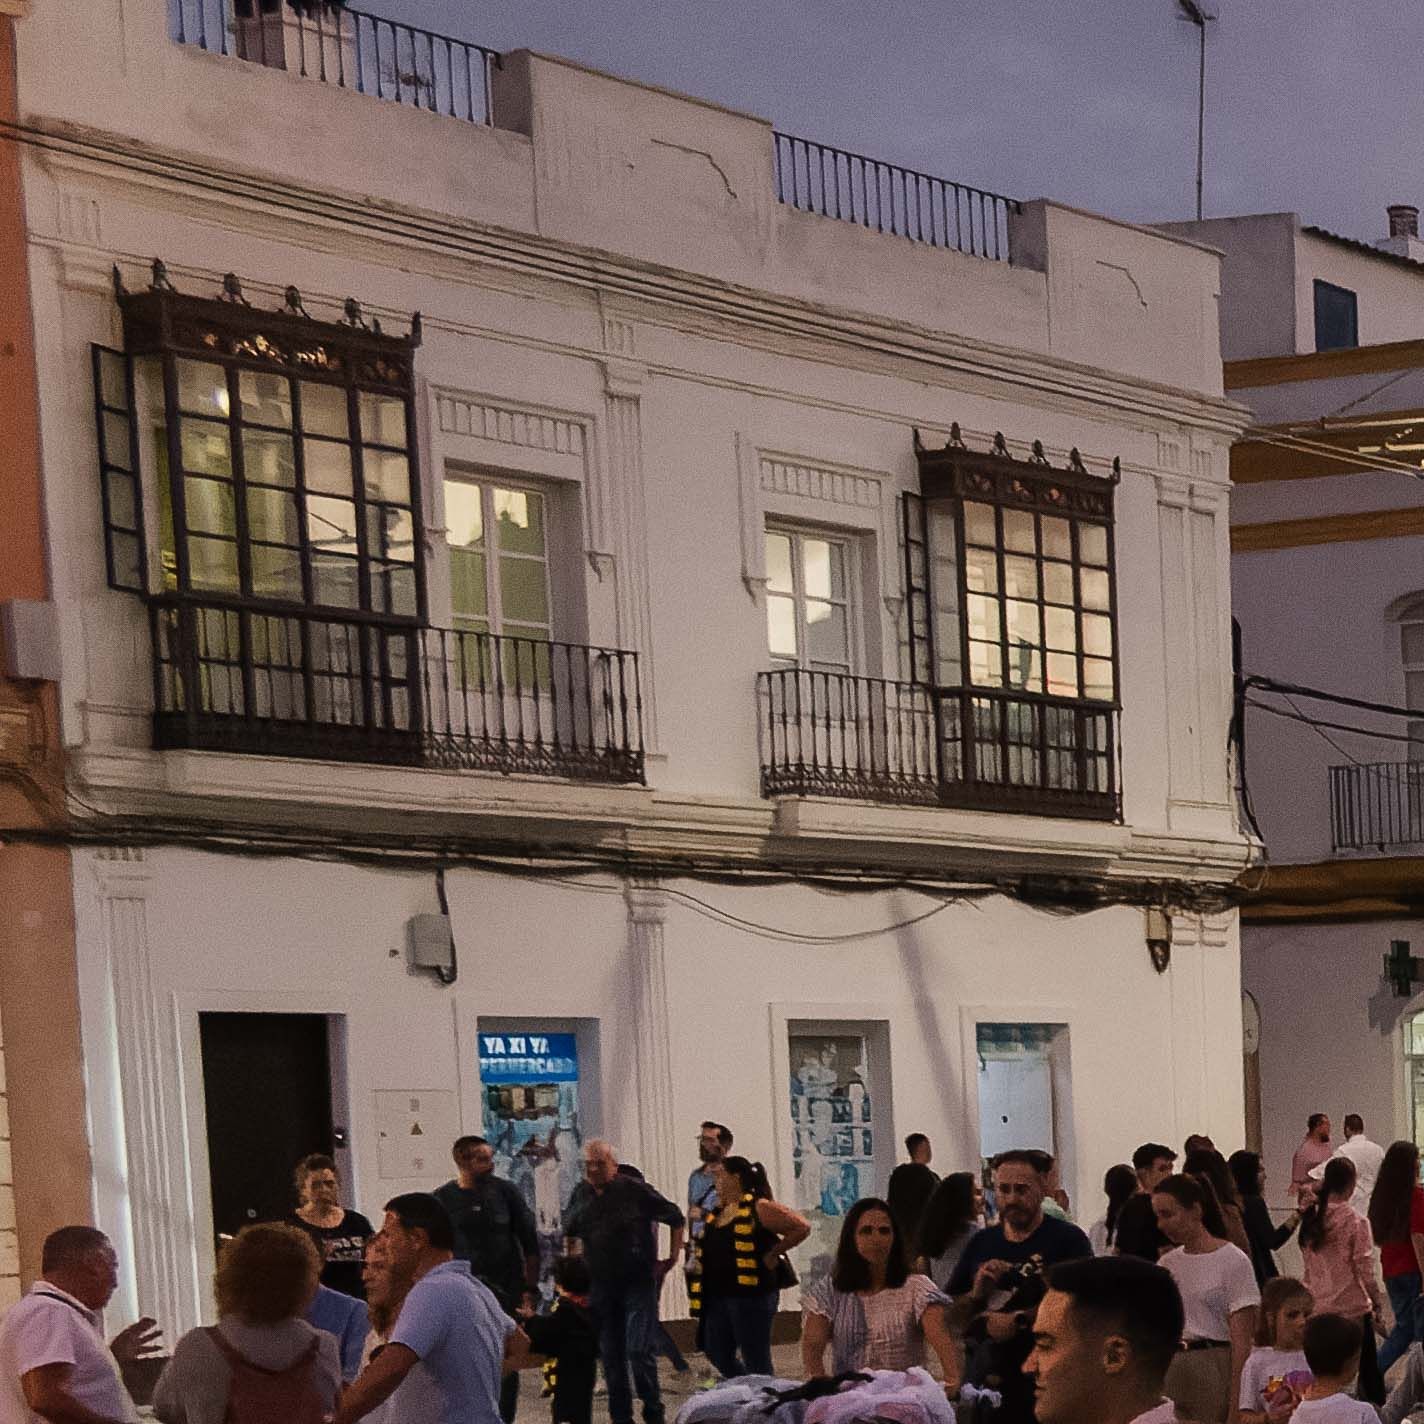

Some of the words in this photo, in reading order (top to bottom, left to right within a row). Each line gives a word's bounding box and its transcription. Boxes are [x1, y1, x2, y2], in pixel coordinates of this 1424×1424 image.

[483, 1037, 506, 1054] YA
[508, 1037, 527, 1054] XI
[529, 1037, 551, 1054] YA
